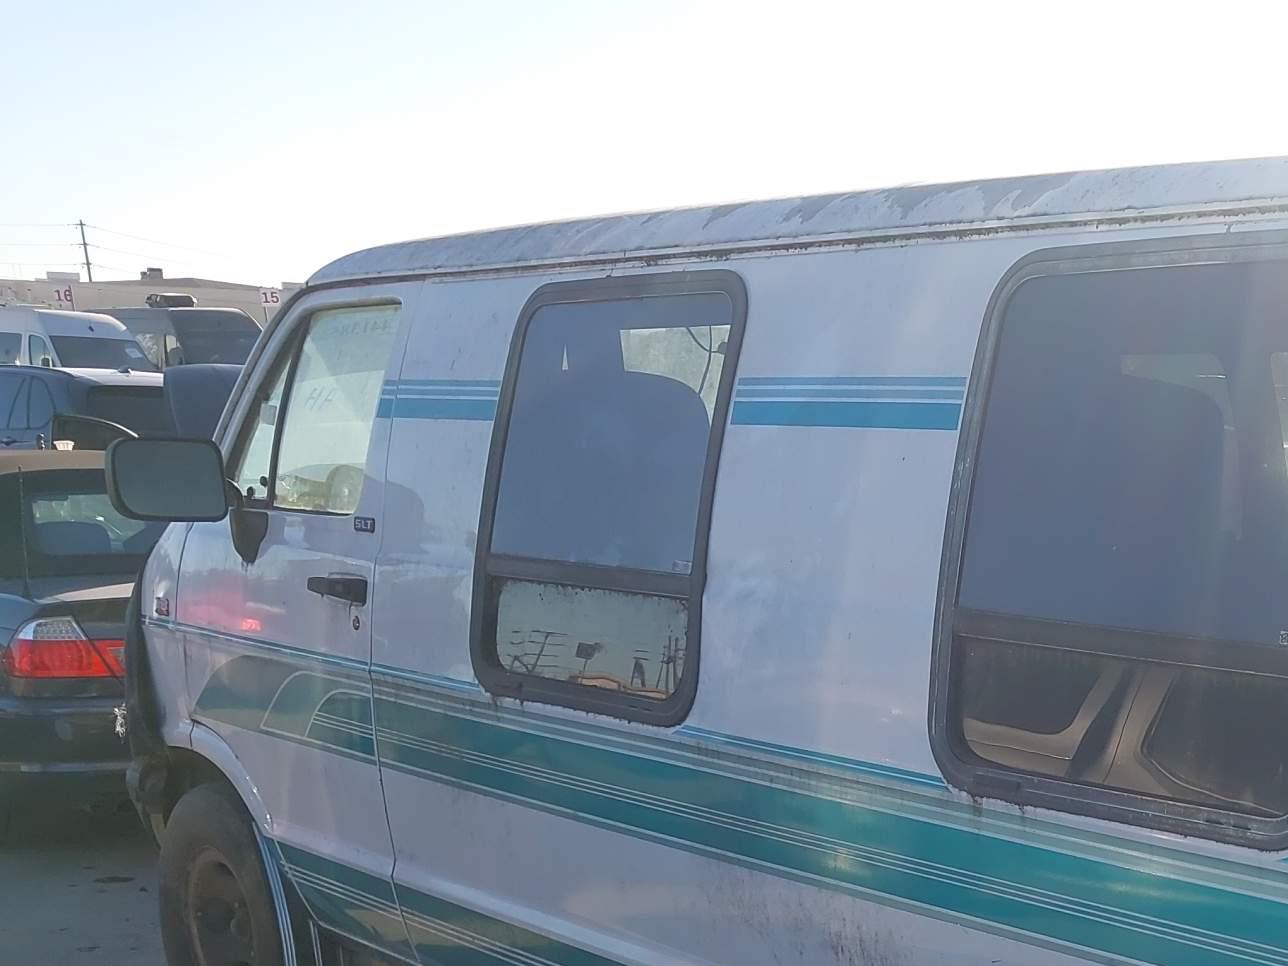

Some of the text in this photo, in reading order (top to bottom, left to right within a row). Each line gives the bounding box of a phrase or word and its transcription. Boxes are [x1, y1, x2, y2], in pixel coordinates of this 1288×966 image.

[54, 289, 73, 302] 16
[262, 291, 280, 304] 15
[355, 519, 373, 530] SLT
